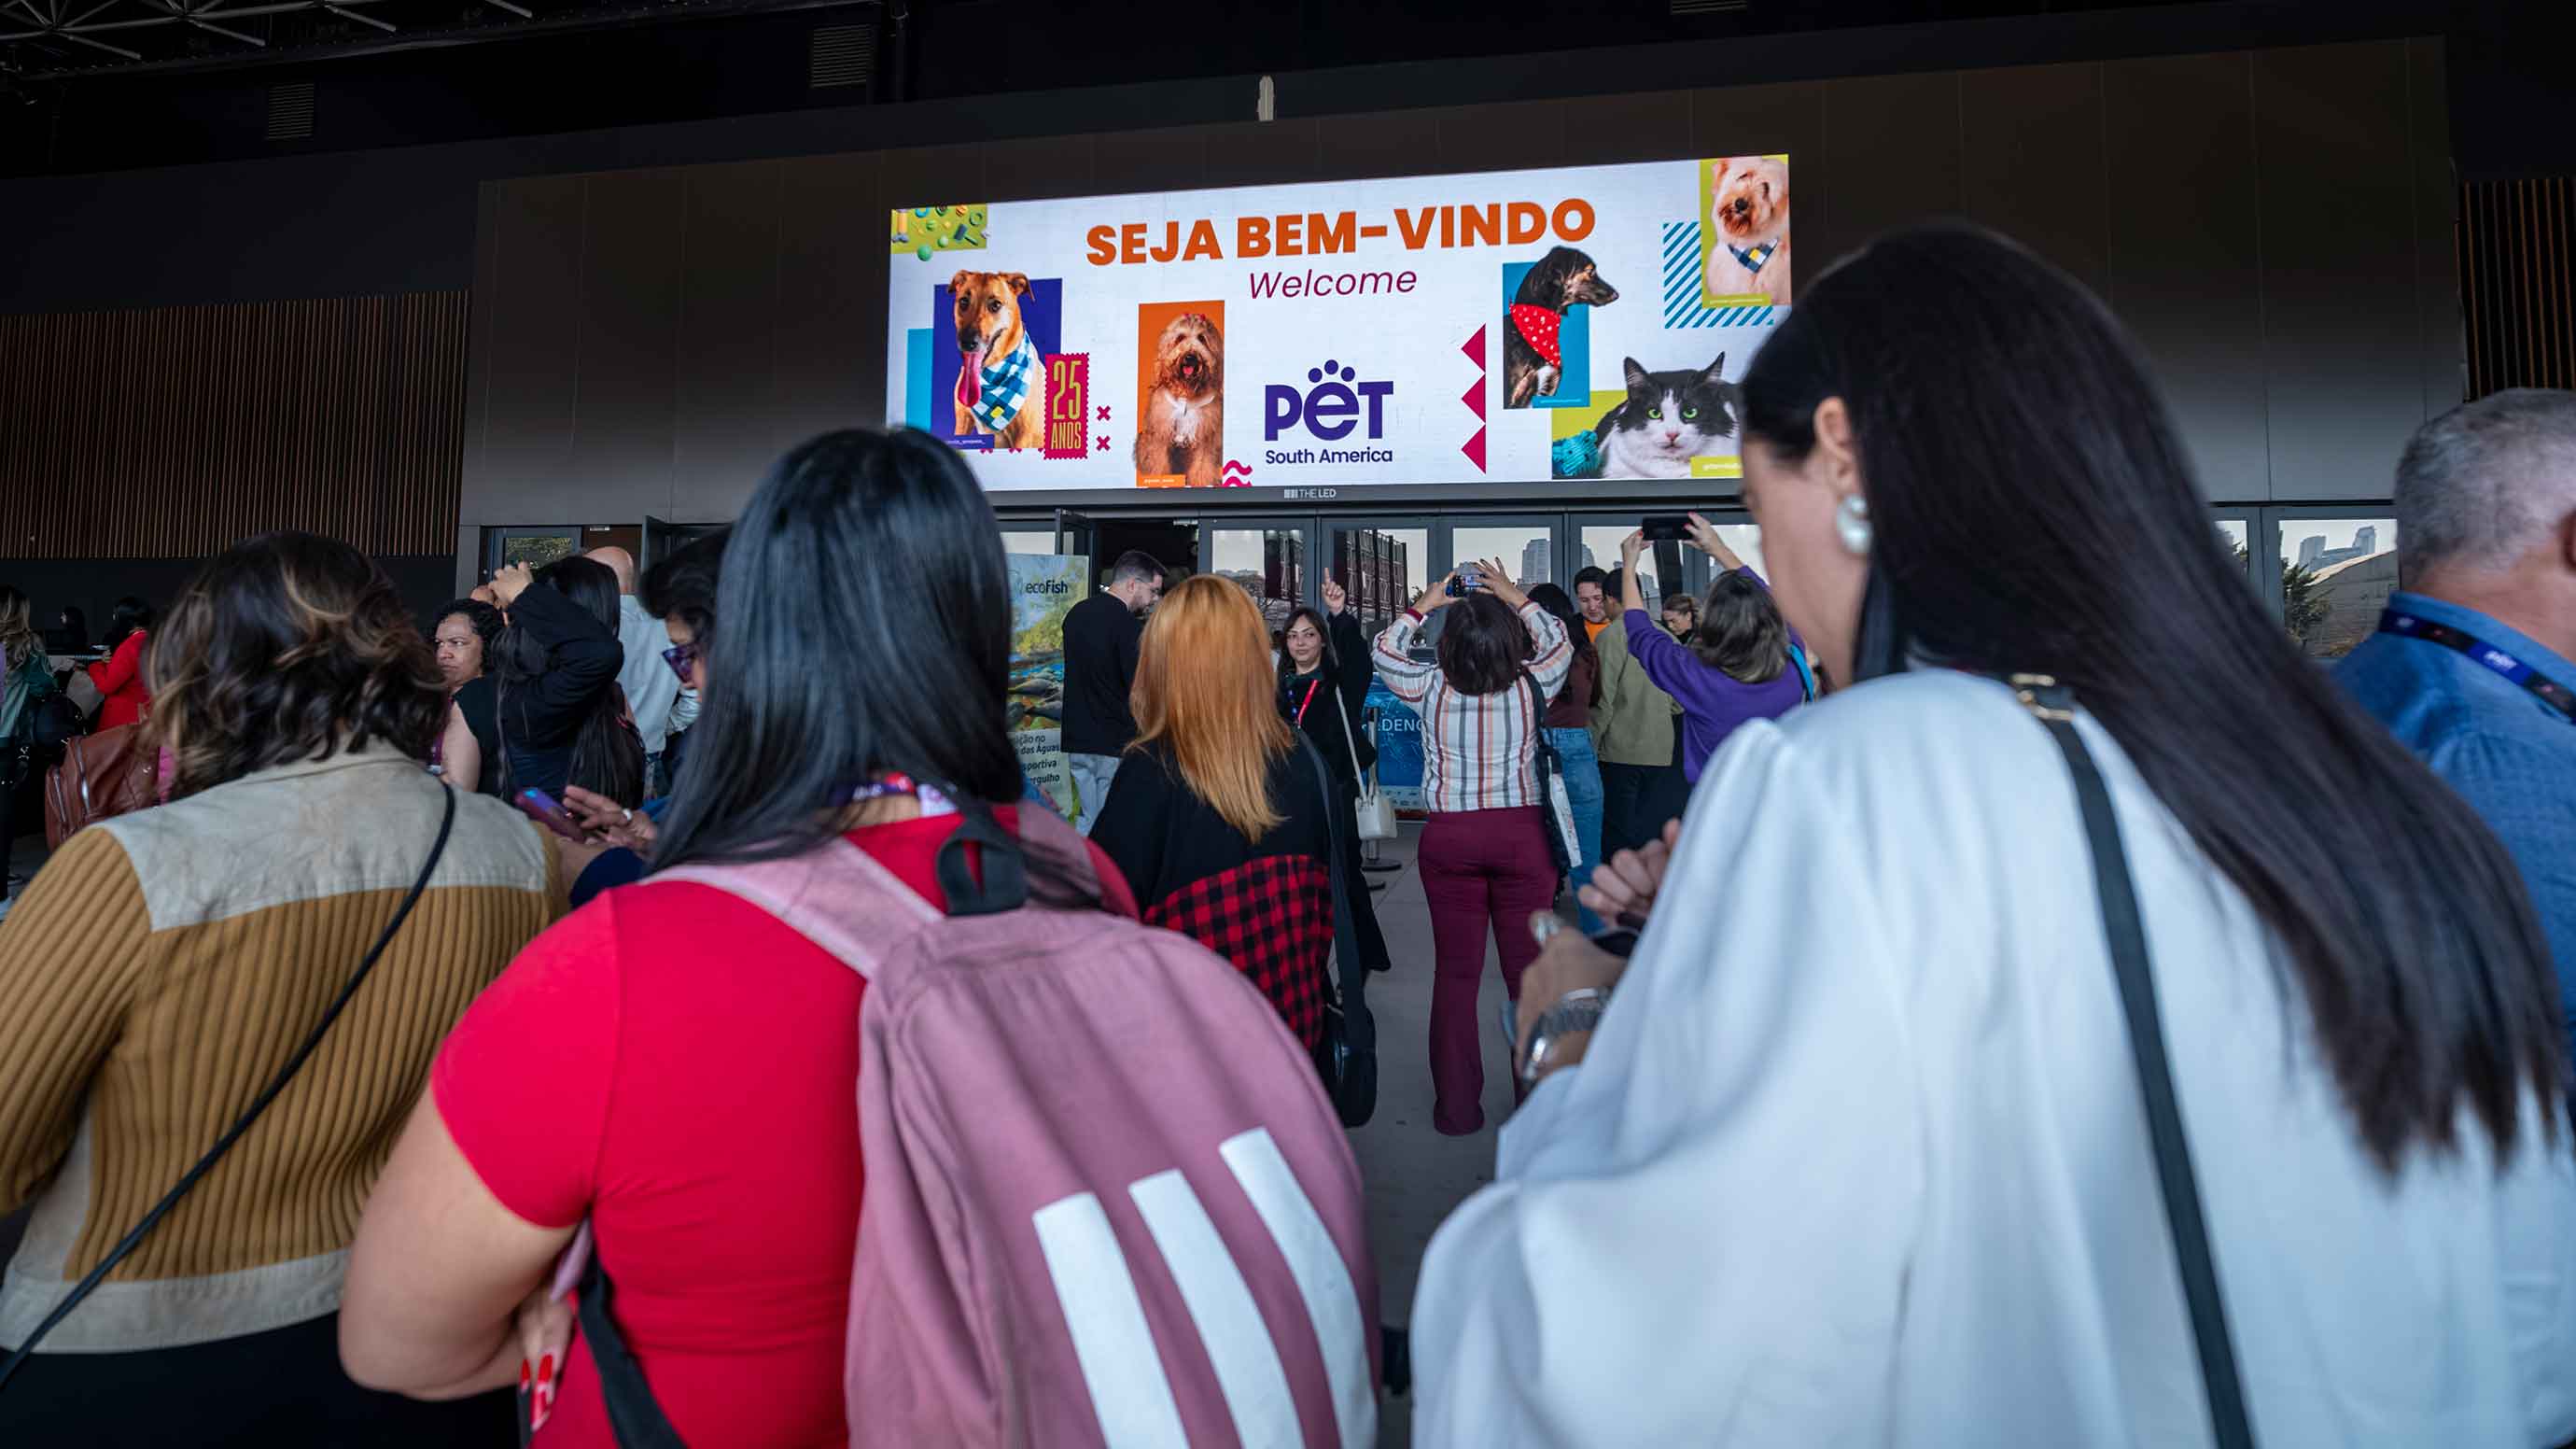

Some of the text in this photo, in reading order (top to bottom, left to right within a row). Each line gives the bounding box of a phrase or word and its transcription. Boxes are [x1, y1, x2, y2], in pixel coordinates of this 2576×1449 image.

[1086, 199, 1596, 266] SEJA BEM-VINDO
[1249, 268, 1418, 300] Welcome
[1053, 360, 1082, 420] 25
[1051, 422, 1082, 450] ANOS
[1265, 446, 1393, 465] South America
[1298, 489, 1337, 499] THE LED
